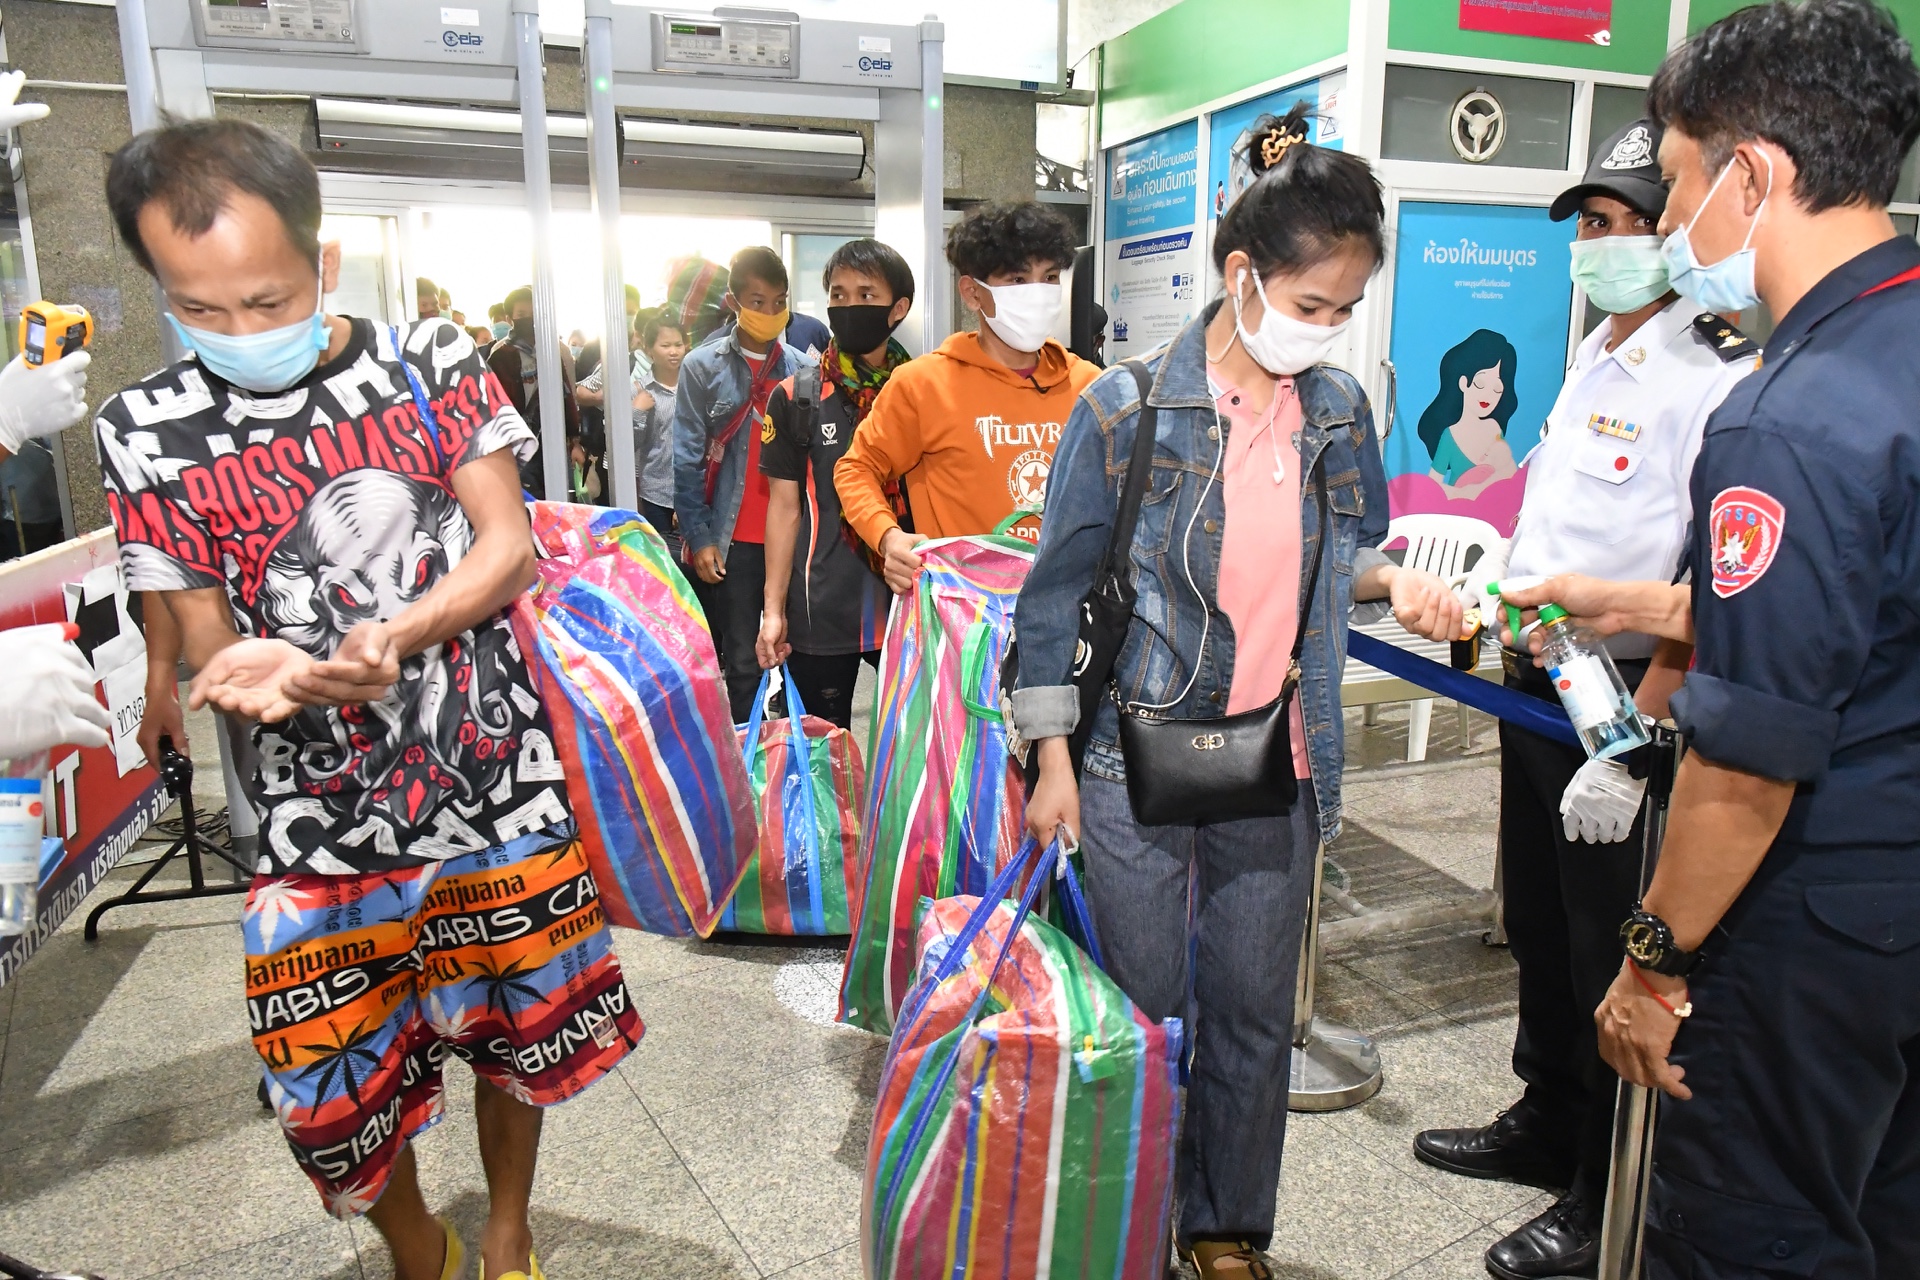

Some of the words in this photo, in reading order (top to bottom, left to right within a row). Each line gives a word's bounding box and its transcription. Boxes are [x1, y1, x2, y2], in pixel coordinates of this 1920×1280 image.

[1423, 237, 1537, 273] ห้องให้นมบุตร
[1724, 507, 1757, 526] TSG
[117, 696, 147, 733] ทางอ
